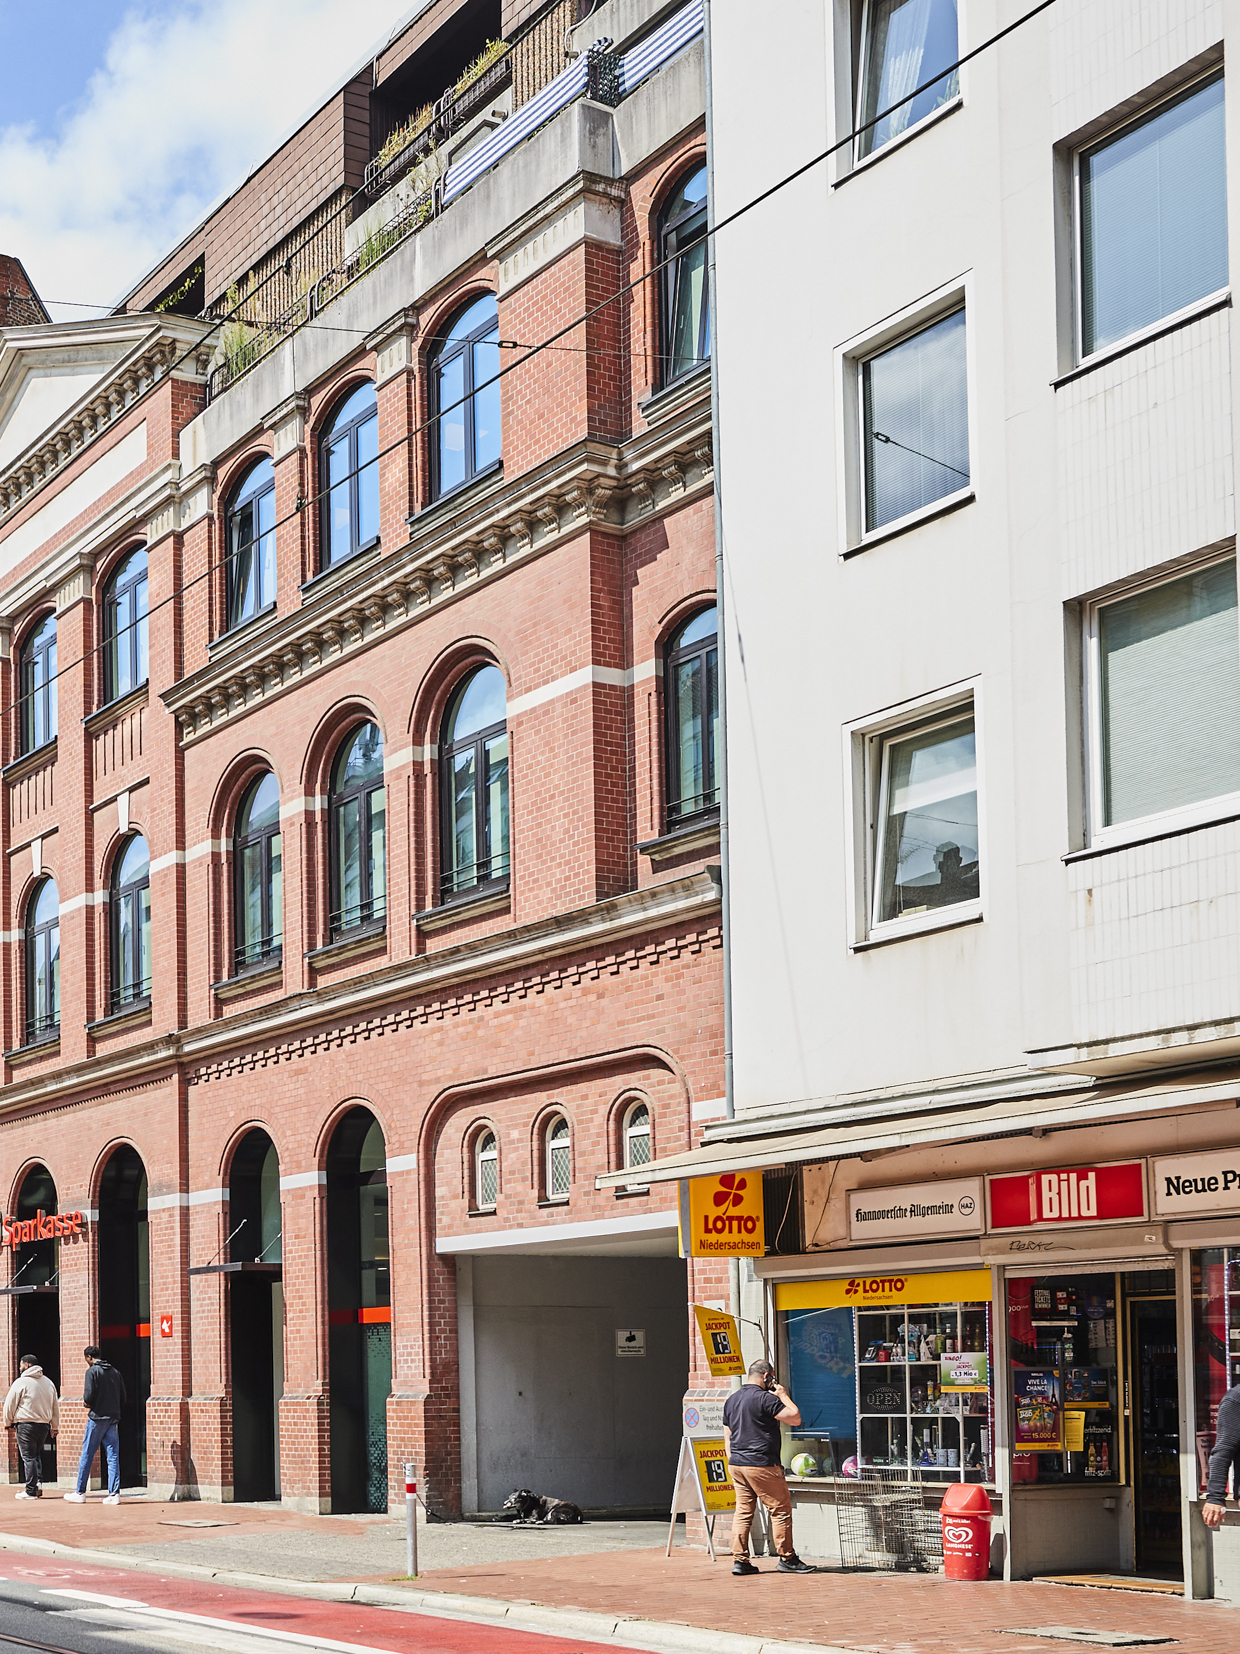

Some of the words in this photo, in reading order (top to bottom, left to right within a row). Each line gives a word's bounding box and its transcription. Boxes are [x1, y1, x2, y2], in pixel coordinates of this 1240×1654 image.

[1164, 1175, 1219, 1196] Neue
[1221, 1169, 1240, 1191] P
[1041, 1171, 1098, 1219] Bild
[909, 1201, 955, 1218] Allgemeine
[3, 1208, 83, 1251] Sparkasse
[703, 1214, 757, 1234] LOTTO
[699, 1239, 761, 1250] Niedersachsen
[862, 1278, 905, 1293] LOTTO
[705, 1322, 731, 1330] JACKPOT
[717, 1332, 731, 1353] 19
[710, 1355, 741, 1364] MILLIONEN
[867, 1392, 901, 1405] OPEN
[700, 1449, 727, 1458] JACKPOT
[711, 1460, 725, 1481] 19
[706, 1484, 735, 1492] MILLIONEN
